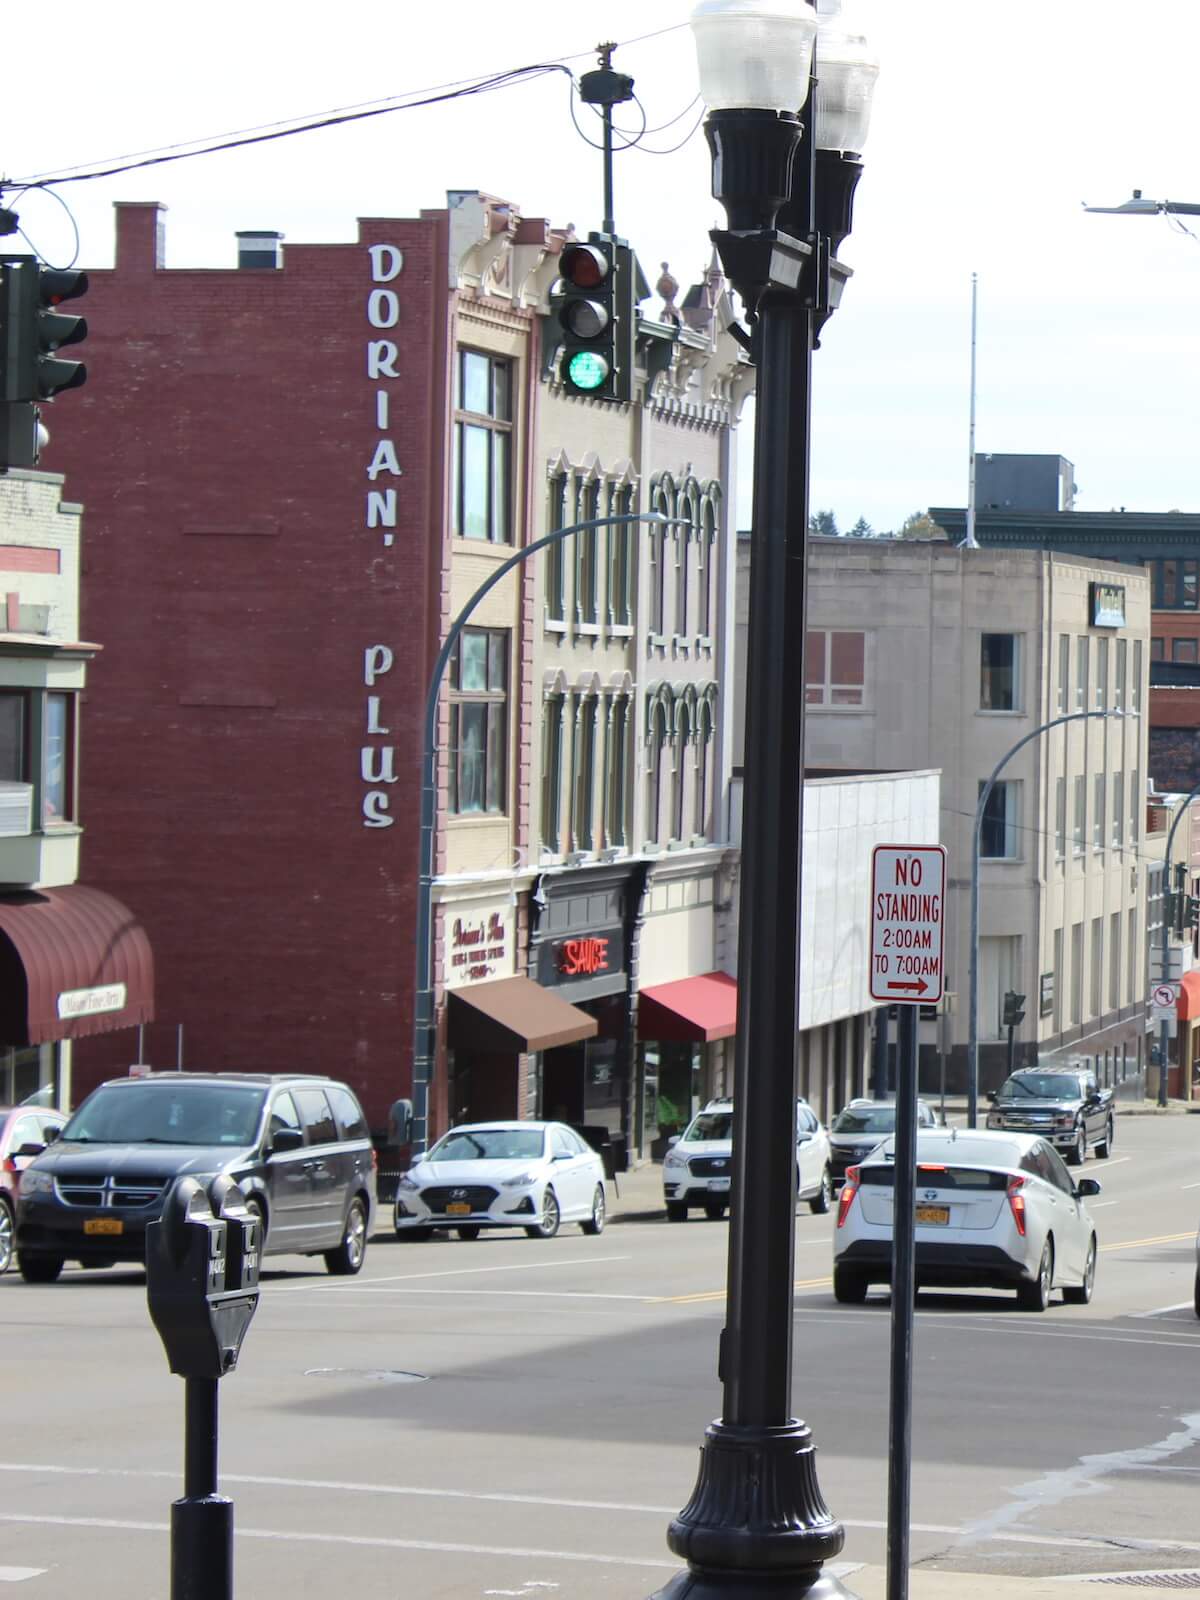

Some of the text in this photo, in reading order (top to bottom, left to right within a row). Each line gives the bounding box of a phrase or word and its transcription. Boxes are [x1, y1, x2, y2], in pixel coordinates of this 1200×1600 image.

[361, 645, 399, 828] PLUS
[896, 858, 922, 887] NO
[877, 893, 939, 923] STANDING
[883, 928, 931, 949] 2:00AM
[562, 937, 608, 975] SAUCE
[875, 954, 938, 976] TO 7:00AM
